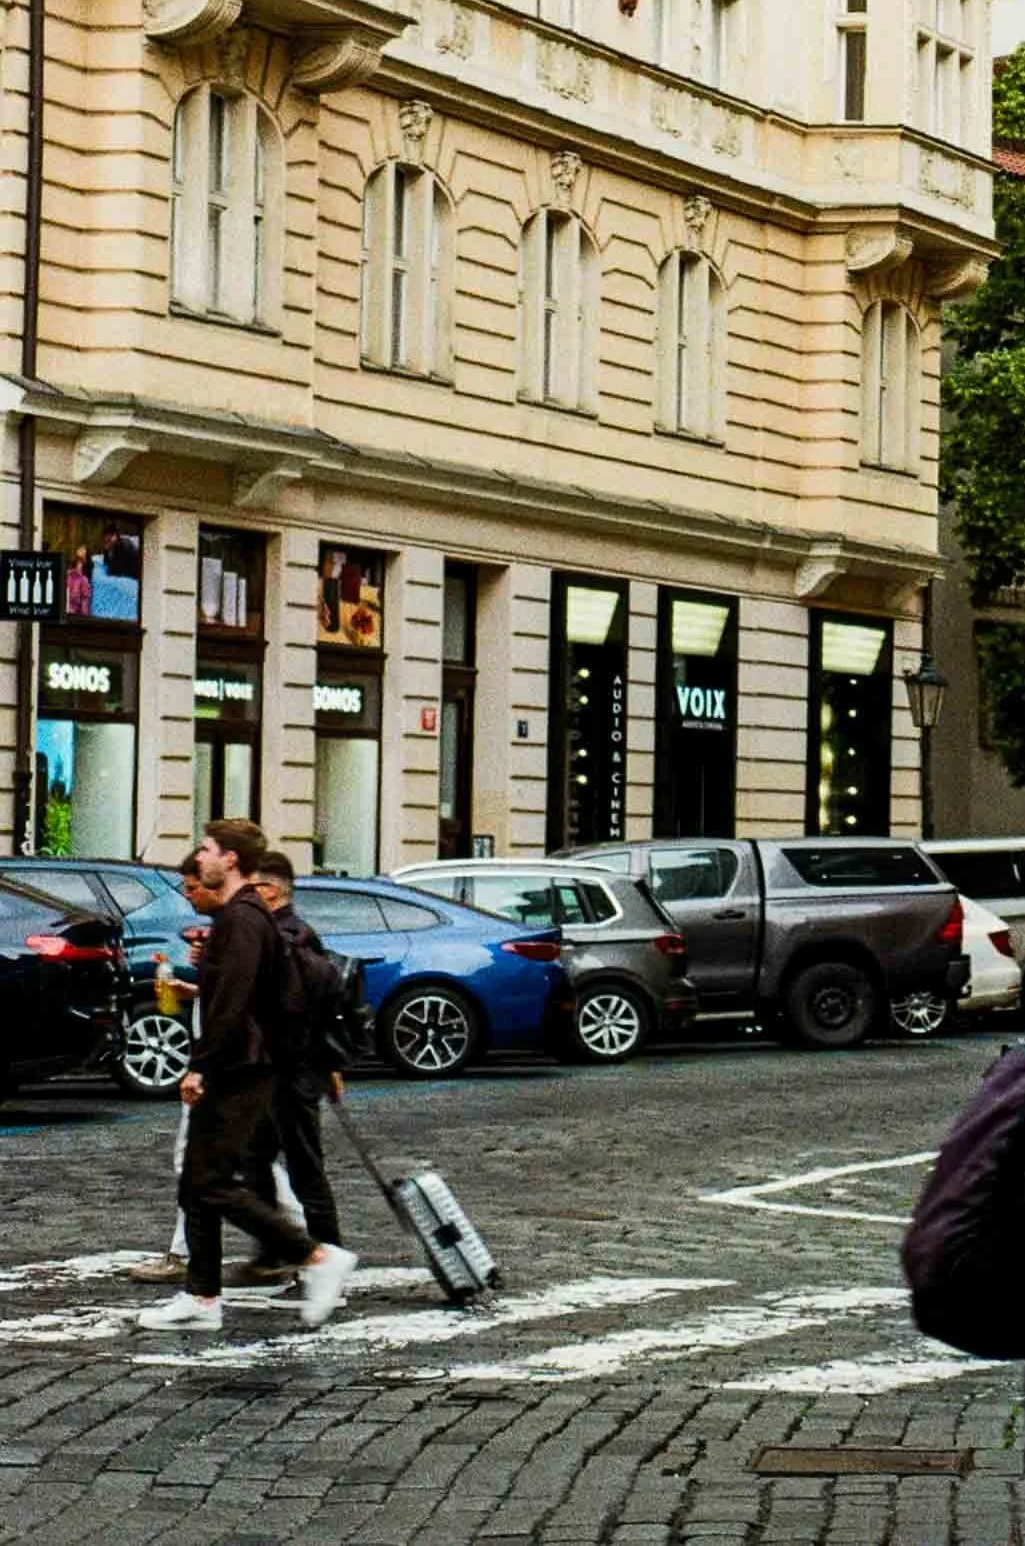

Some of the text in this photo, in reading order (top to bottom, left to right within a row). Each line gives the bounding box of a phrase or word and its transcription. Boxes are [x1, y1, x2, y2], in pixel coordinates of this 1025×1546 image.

[49, 662, 110, 693] SONOS
[313, 685, 362, 713] SONOS
[611, 675, 622, 742] AUDIO
[676, 685, 726, 719] VOIX
[610, 772, 621, 837] CINEM
